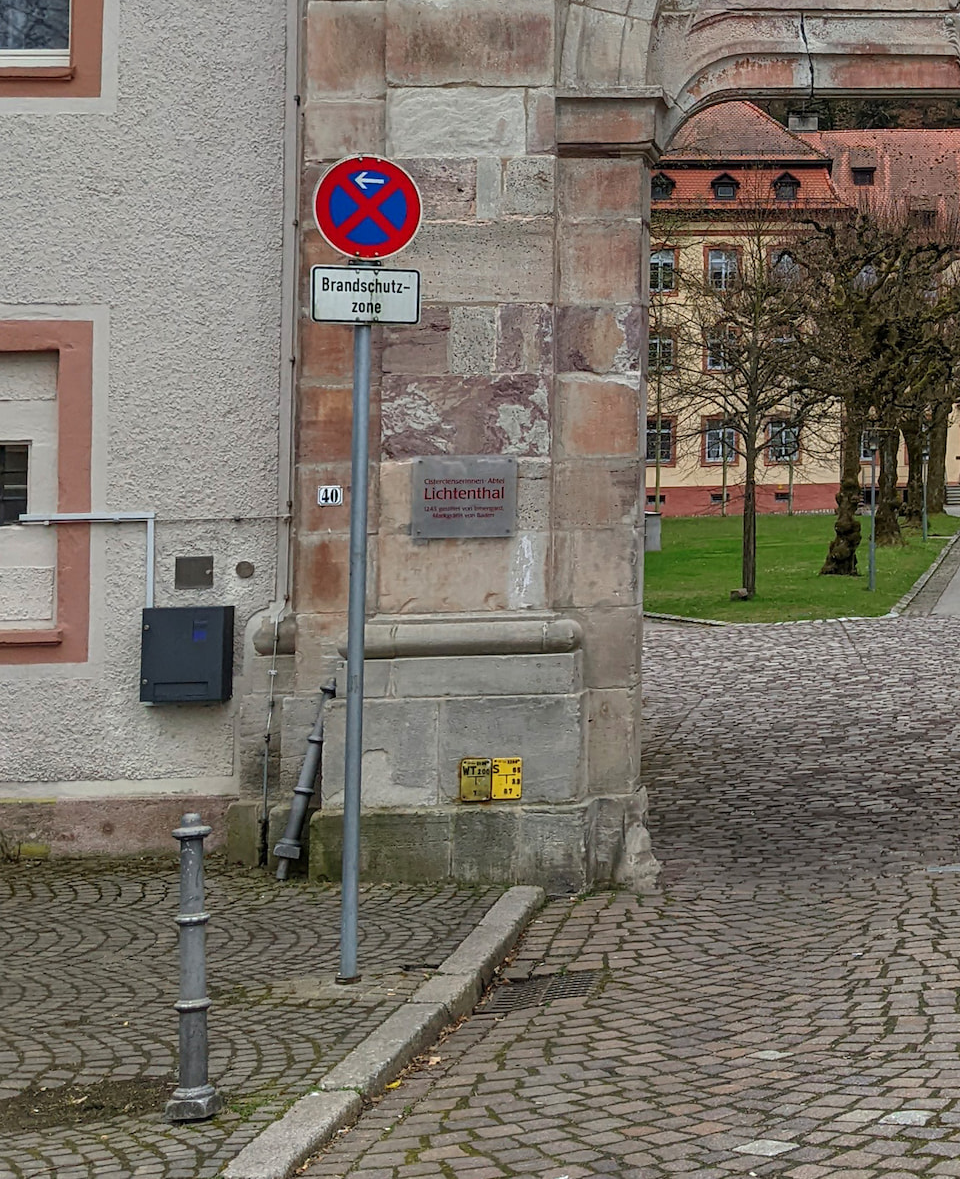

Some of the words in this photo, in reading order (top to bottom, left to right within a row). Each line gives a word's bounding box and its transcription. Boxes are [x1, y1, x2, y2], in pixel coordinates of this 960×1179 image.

[322, 277, 411, 294] Brandschutz-
[351, 302, 382, 314] zone
[321, 488, 339, 503] 40
[424, 486, 505, 500] Lichtenthal
[492, 764, 500, 773] S
